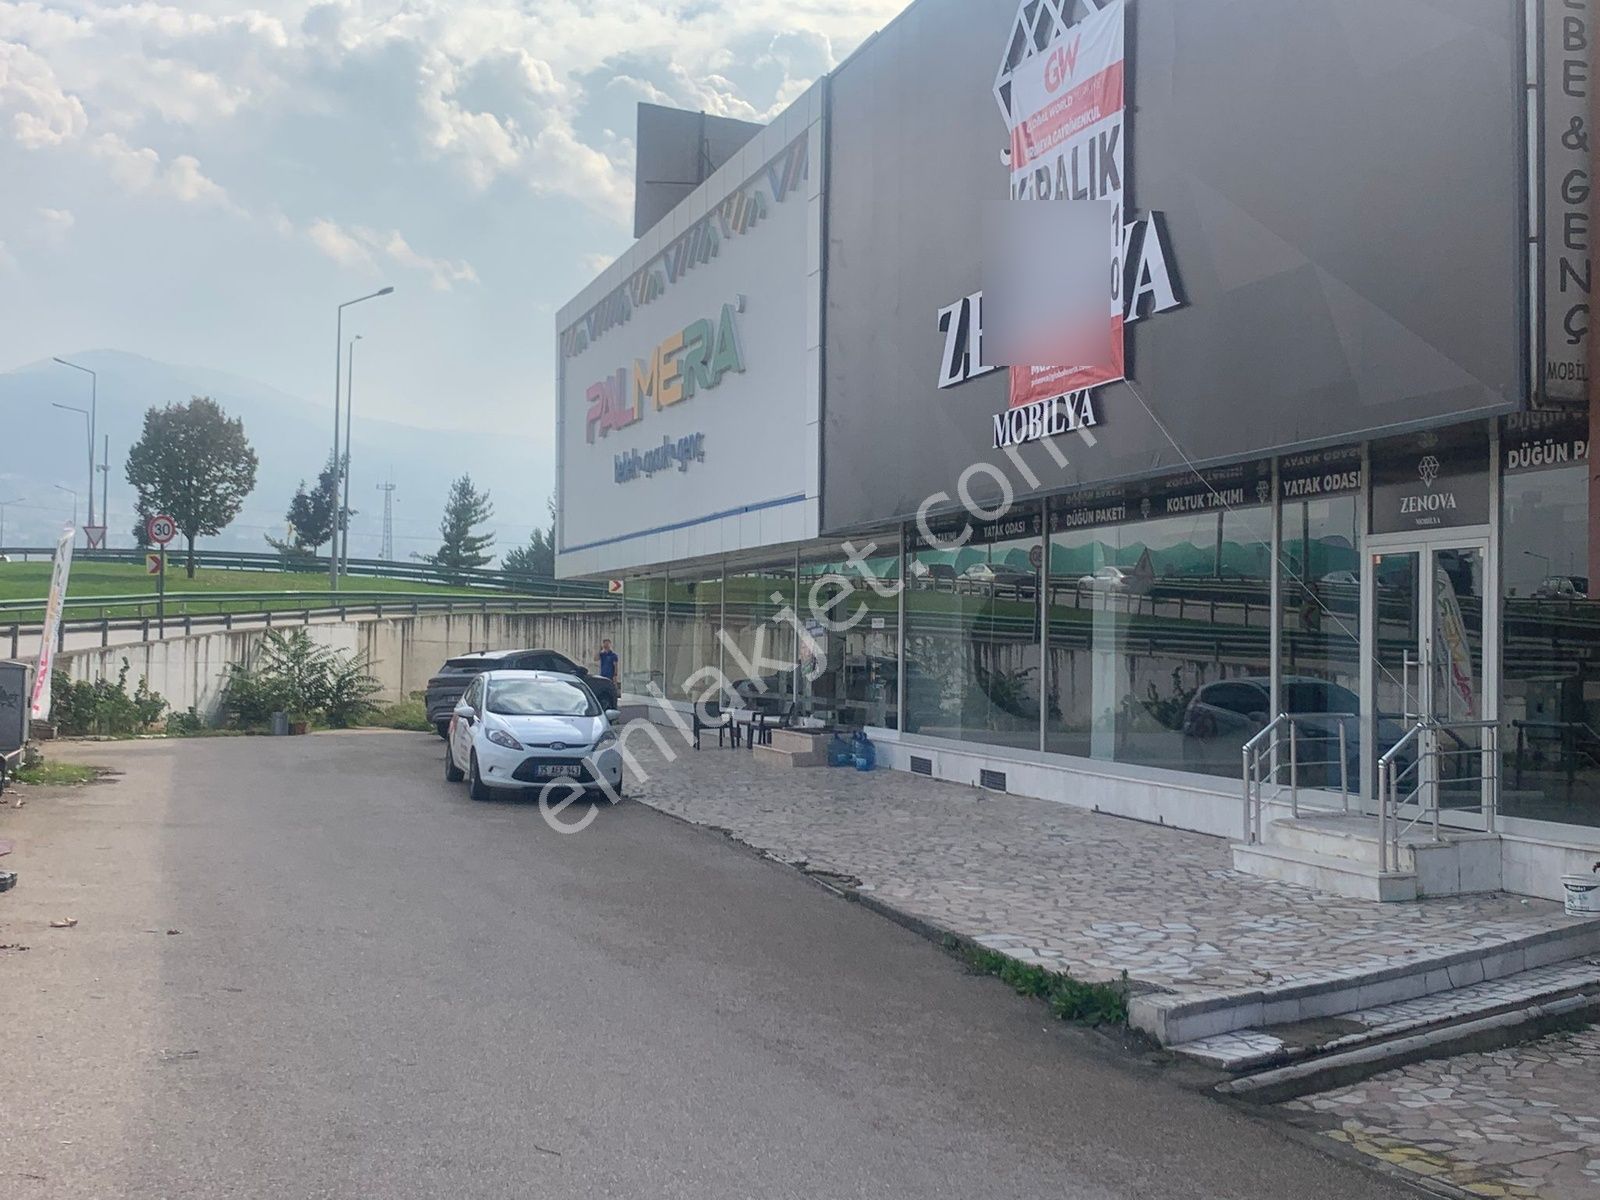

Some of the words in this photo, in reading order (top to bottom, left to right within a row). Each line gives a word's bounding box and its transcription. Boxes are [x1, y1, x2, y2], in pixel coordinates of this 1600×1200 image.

[1045, 33, 1081, 93] GW
[586, 303, 744, 444] PALMERA
[1508, 439, 1568, 469] DÜĞÜN
[1283, 477, 1321, 497] YATAK
[1324, 470, 1361, 491] ODASI
[1166, 492, 1205, 512] KOLTUK
[1205, 488, 1244, 507] TAKIMI
[1400, 493, 1457, 513] ZENOVA
[1066, 508, 1094, 528] DÜĞÜN
[1095, 503, 1126, 523] PAKETİ
[154, 523, 170, 537] 30
[983, 523, 1004, 538] YATAK
[1004, 520, 1026, 535] ODASI
